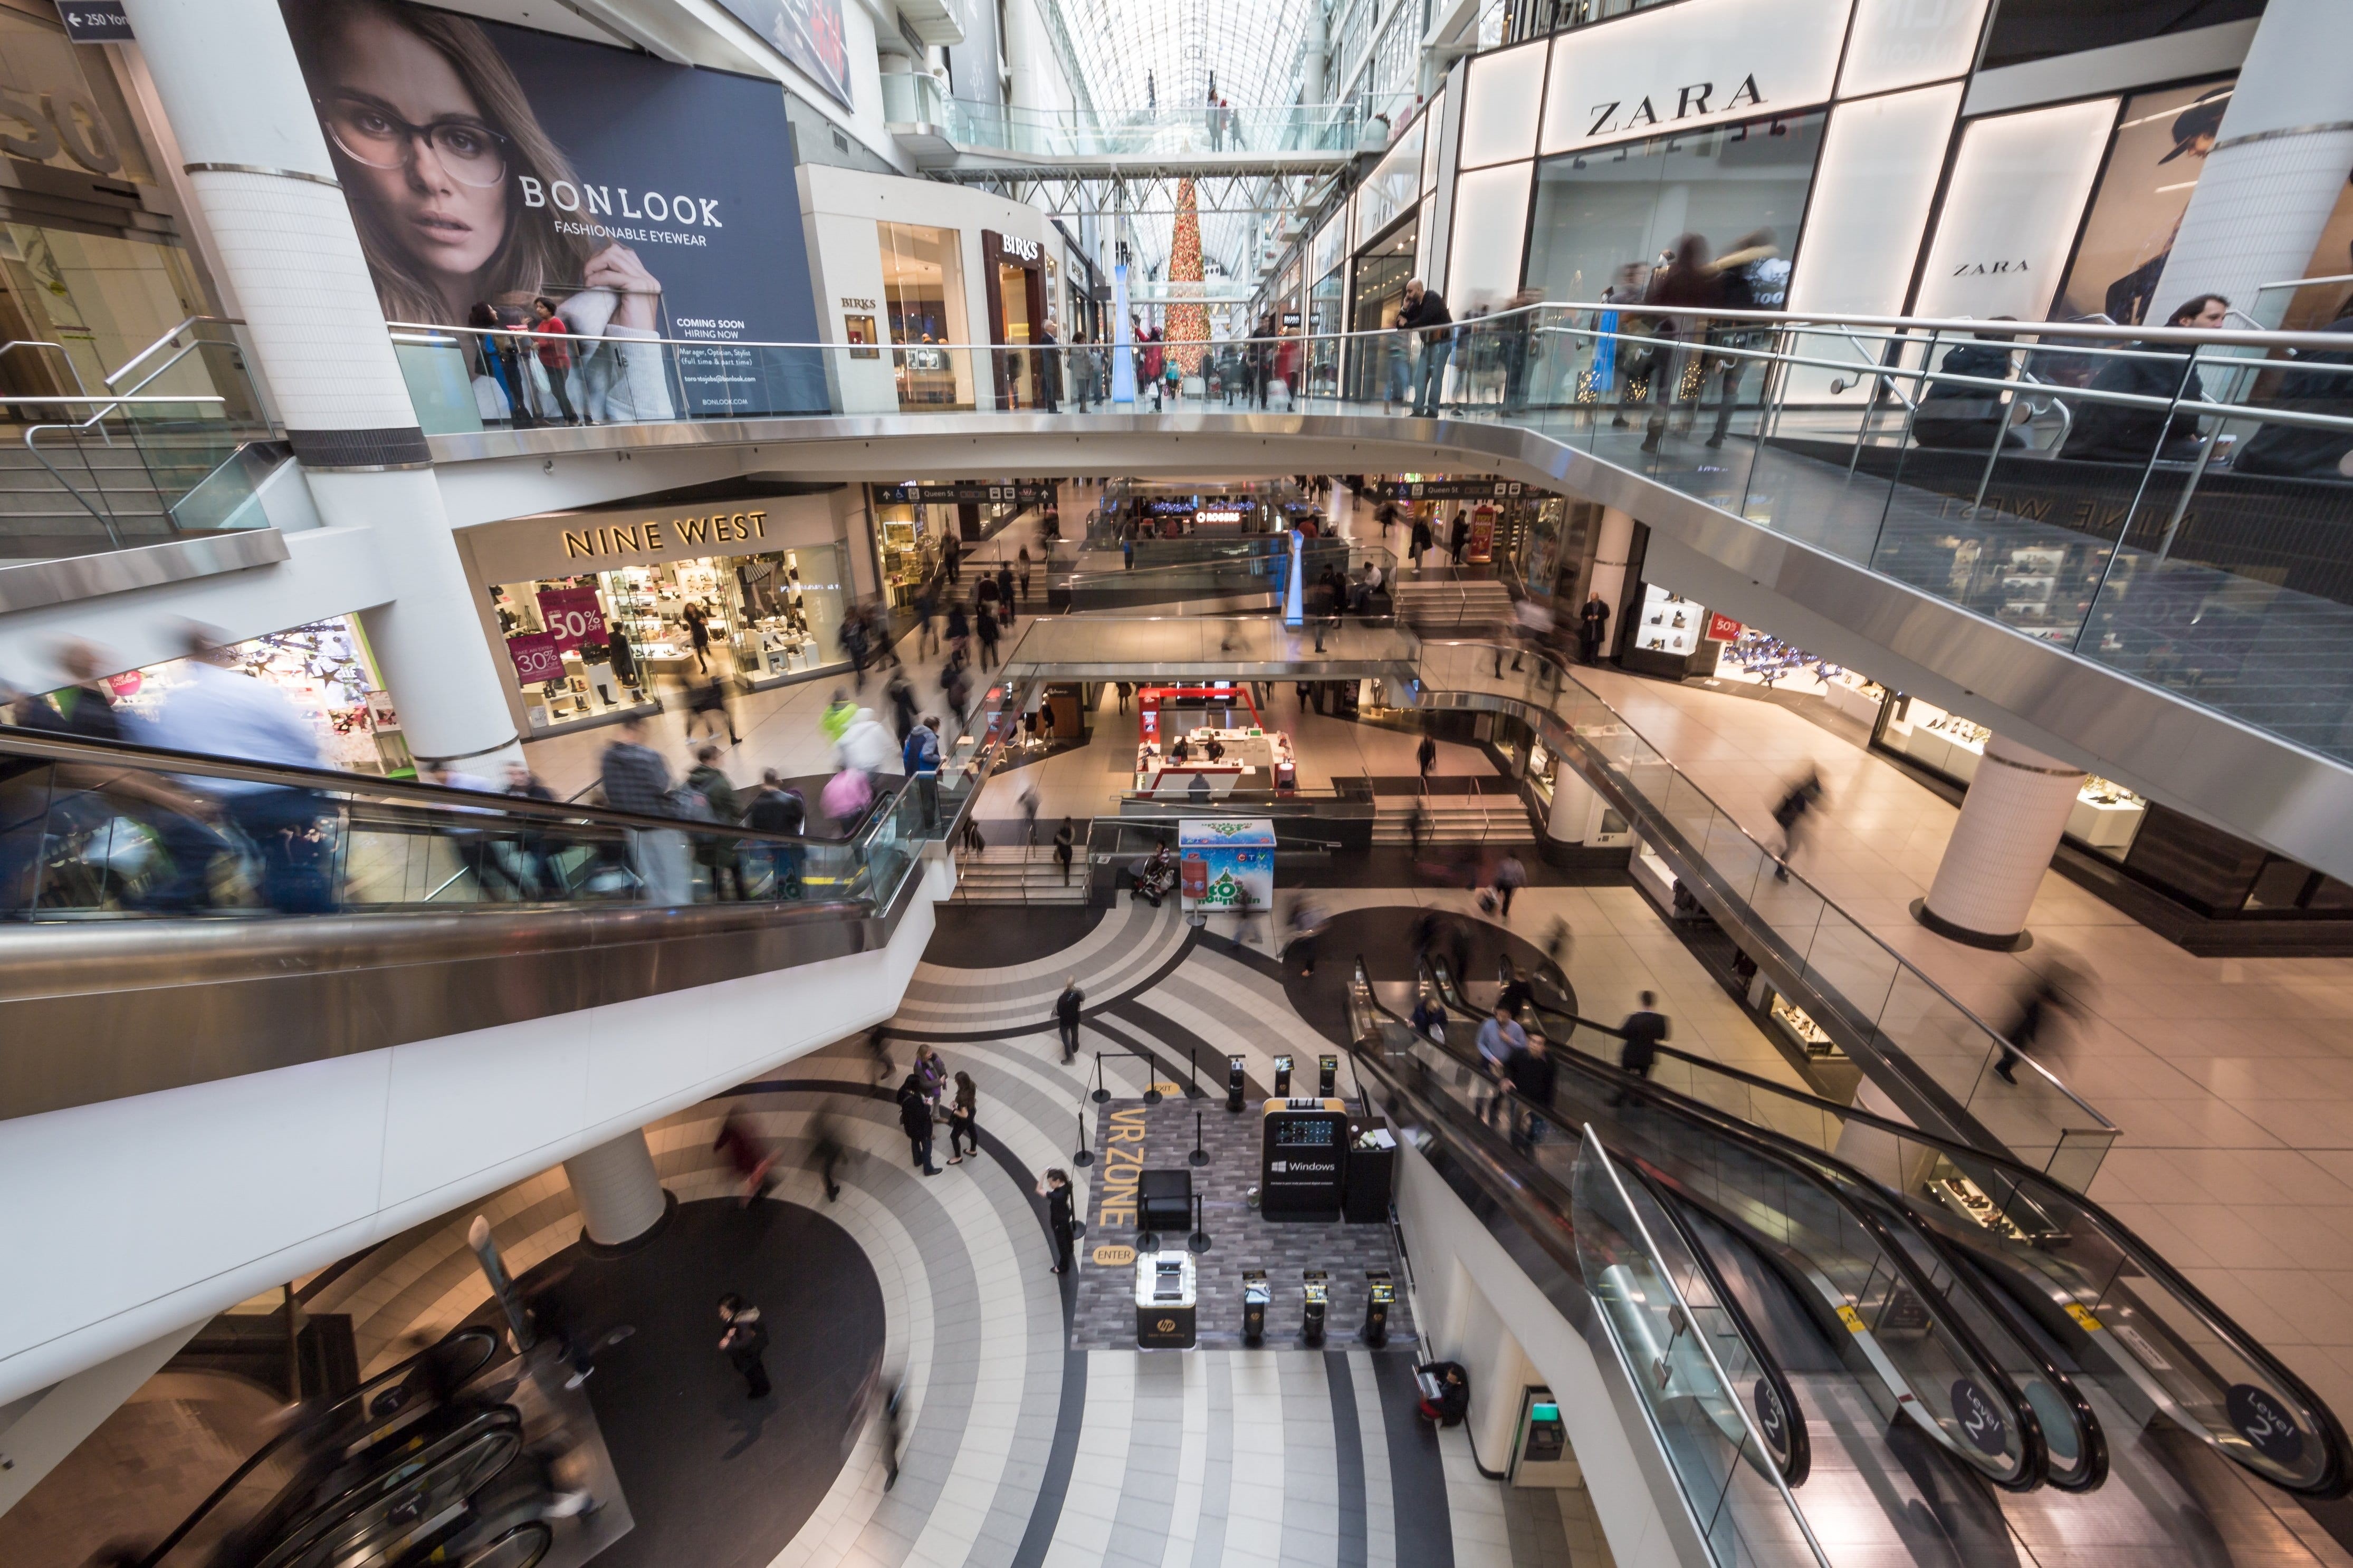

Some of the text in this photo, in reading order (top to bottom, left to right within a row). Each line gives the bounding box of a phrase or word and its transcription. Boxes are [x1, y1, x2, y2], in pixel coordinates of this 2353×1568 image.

[85, 14, 106, 26] 250
[1586, 72, 1768, 137] ZARA
[519, 175, 722, 228] BONLOOK
[1372, 198, 1393, 233] ZARA
[554, 220, 707, 247] FASHIONABLE EYEWEAR
[1003, 234, 1038, 261] BIRKS
[1952, 259, 2029, 277] ZARA
[841, 297, 876, 310] BIRKS
[676, 318, 745, 329] COMING SOON
[684, 329, 739, 339] HIRING NOW
[734, 349, 751, 358] Stylist
[1206, 512, 1240, 522] ROGERS
[565, 513, 767, 558] NINE WEST
[548, 610, 600, 640] 50%
[518, 649, 557, 672] 30%
[1108, 1108, 1146, 1143] VR
[1289, 1162, 1335, 1171] Windows
[1098, 1250, 1131, 1260] ENTER
[1157, 1319, 1175, 1333] hp
[1967, 1387, 2000, 1431] Level
[2247, 1392, 2294, 1437] Level
[1764, 1408, 1779, 1438] 2
[1965, 1409, 1984, 1440] 2
[2245, 1414, 2273, 1446] 2
